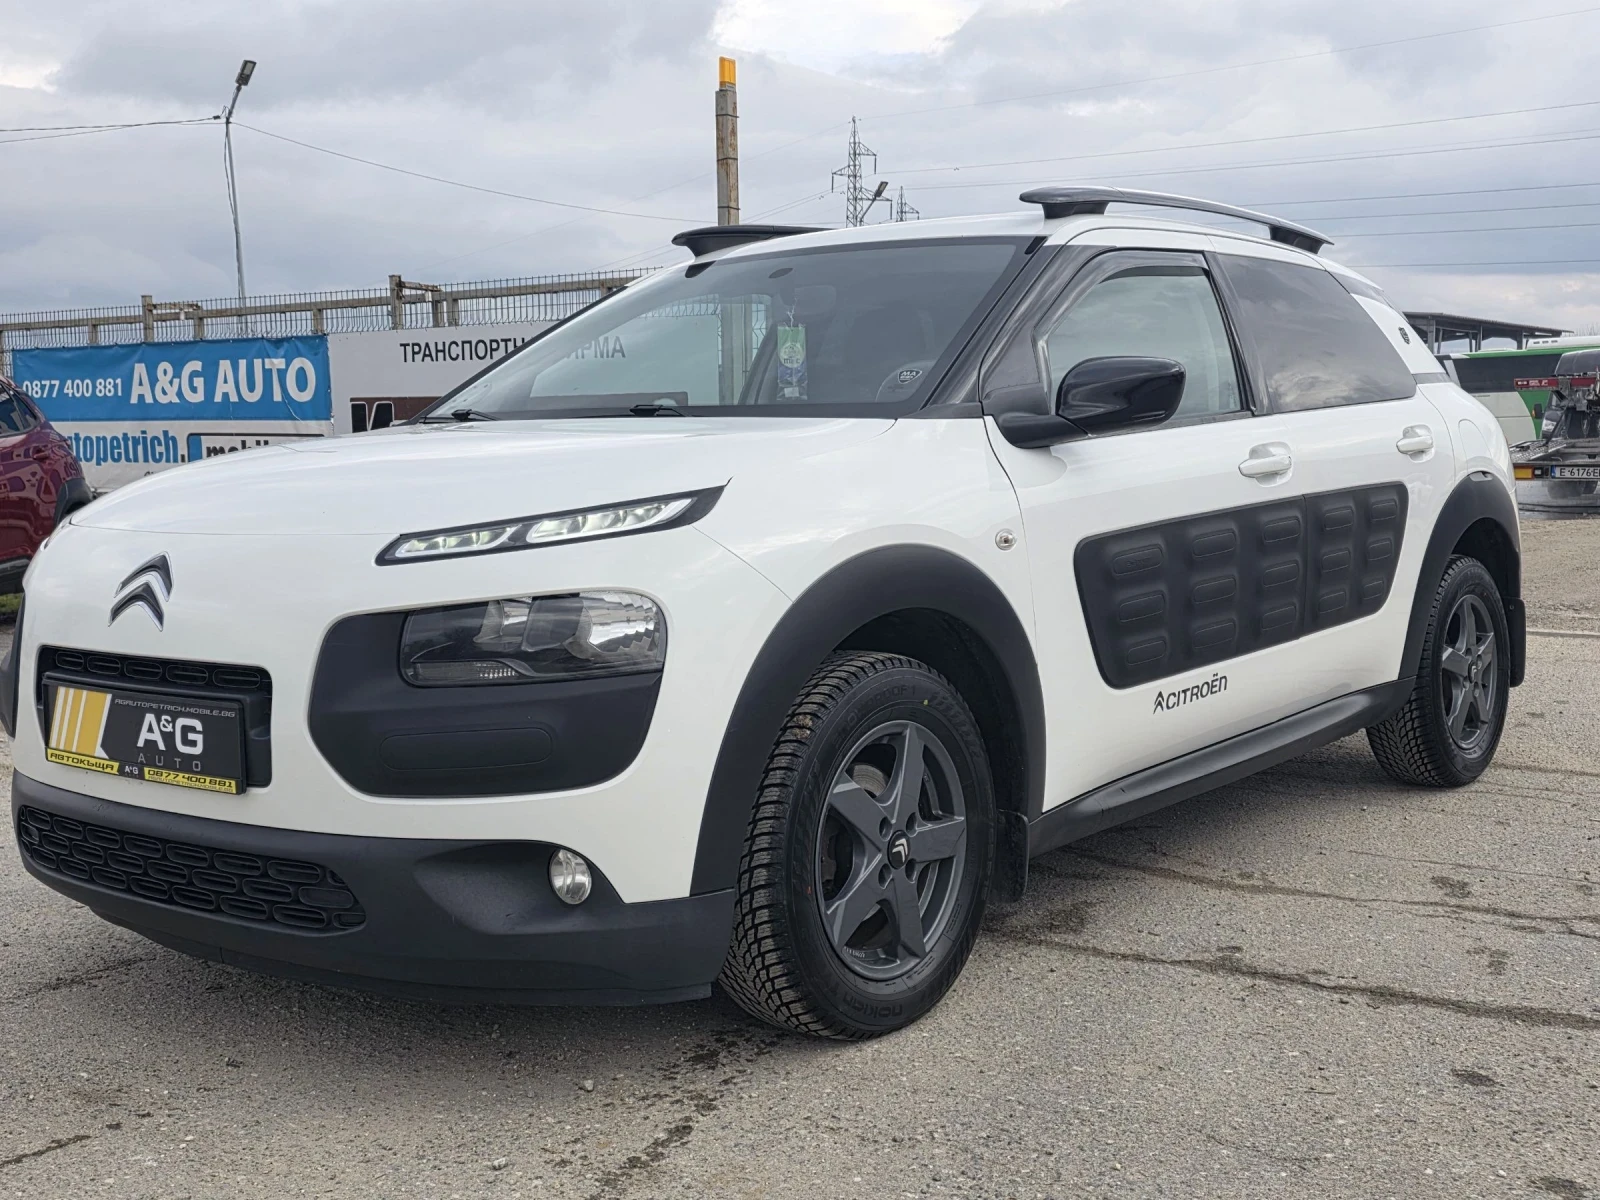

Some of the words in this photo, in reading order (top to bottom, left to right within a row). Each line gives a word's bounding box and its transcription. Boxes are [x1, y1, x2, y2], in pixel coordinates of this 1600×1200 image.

[22, 379, 60, 399] 0877
[63, 378, 94, 399] 400
[95, 377, 122, 398] 881
[129, 360, 205, 405] A&G
[213, 356, 317, 404] AUTO
[114, 697, 236, 719] AGAUTOPETRICH.MOBILE.BG
[136, 713, 204, 755] A&G
[49, 752, 115, 771] АВТОКЪЩА
[137, 752, 202, 772] AUTO
[147, 769, 180, 780] 0877
[182, 774, 207, 784] 400
[208, 778, 233, 788] 881
